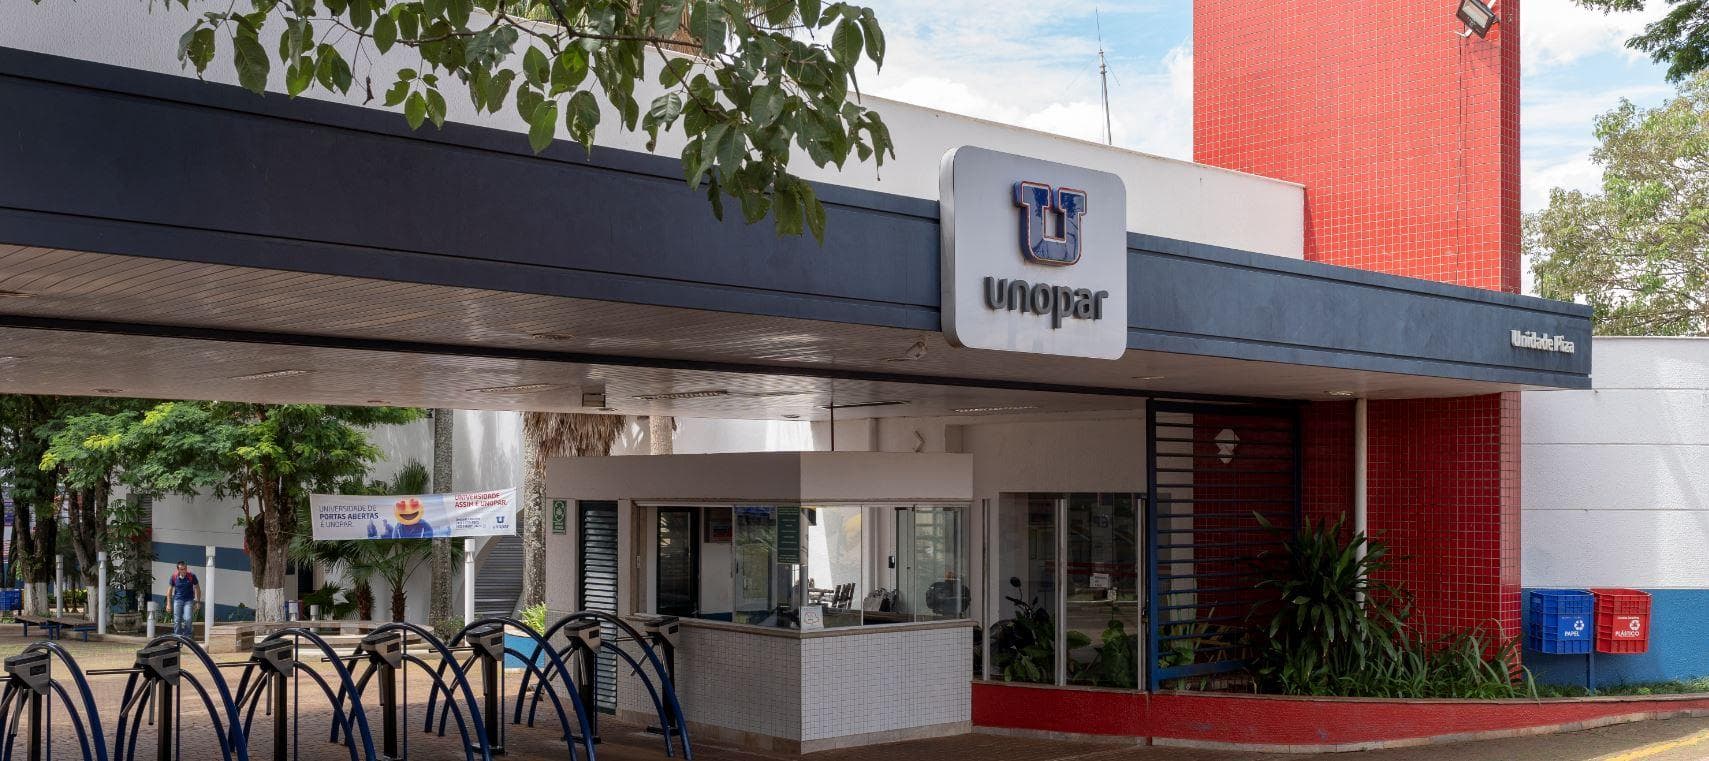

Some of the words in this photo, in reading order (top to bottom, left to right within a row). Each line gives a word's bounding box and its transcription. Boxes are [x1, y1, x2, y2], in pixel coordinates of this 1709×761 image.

[1013, 180, 1088, 267] U
[983, 276, 1109, 330] unopar
[1510, 329, 1553, 351] Unidade
[1553, 335, 1575, 354] Piza
[454, 492, 501, 501] UNIVERSIDADE
[318, 504, 367, 513] UNIVERSIDADE
[367, 504, 377, 512] DE
[1615, 629, 1640, 638] PLÁSTICO
